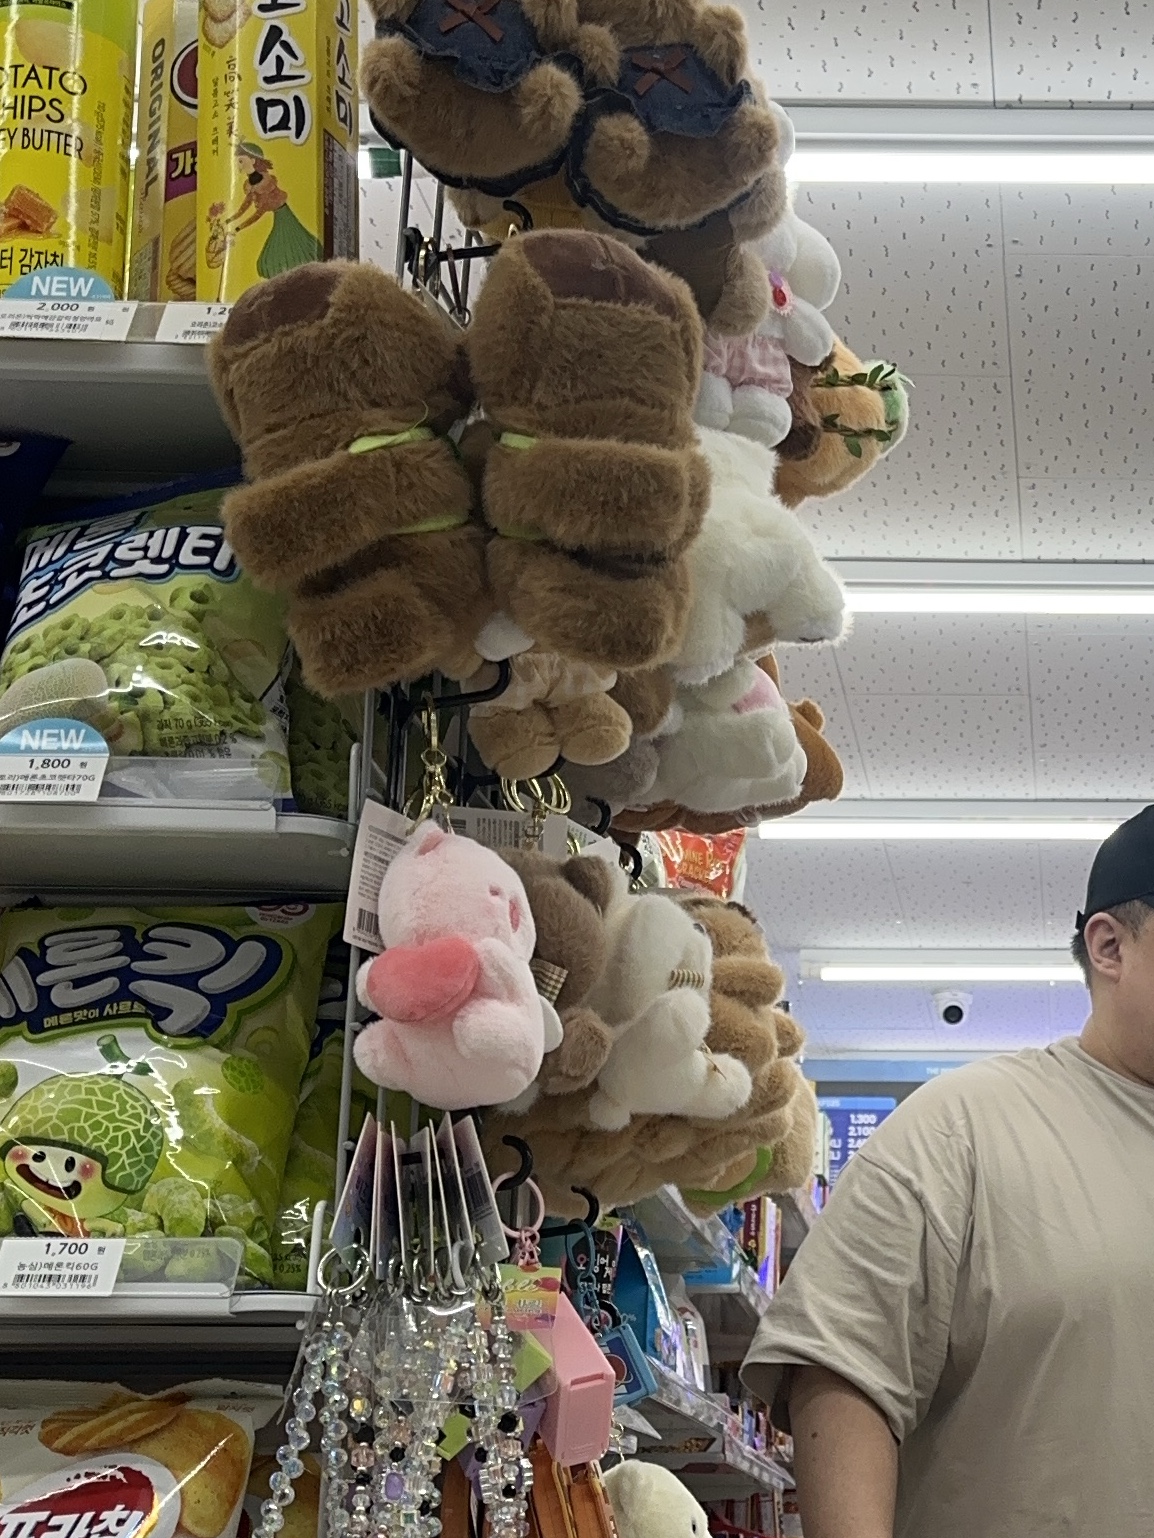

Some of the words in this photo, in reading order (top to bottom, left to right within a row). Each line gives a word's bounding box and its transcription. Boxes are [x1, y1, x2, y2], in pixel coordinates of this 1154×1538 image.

[144, 37, 166, 198] ORIGINAL
[21, 127, 84, 161] BUTTER
[171, 150, 197, 181] 가
[30, 276, 95, 297] NEW
[36, 302, 79, 313] 2,000
[20, 729, 85, 750] NEW
[28, 757, 71, 770] 1,800
[43, 1008, 100, 1028] 메론맛이
[45, 1242, 89, 1256] 1,700
